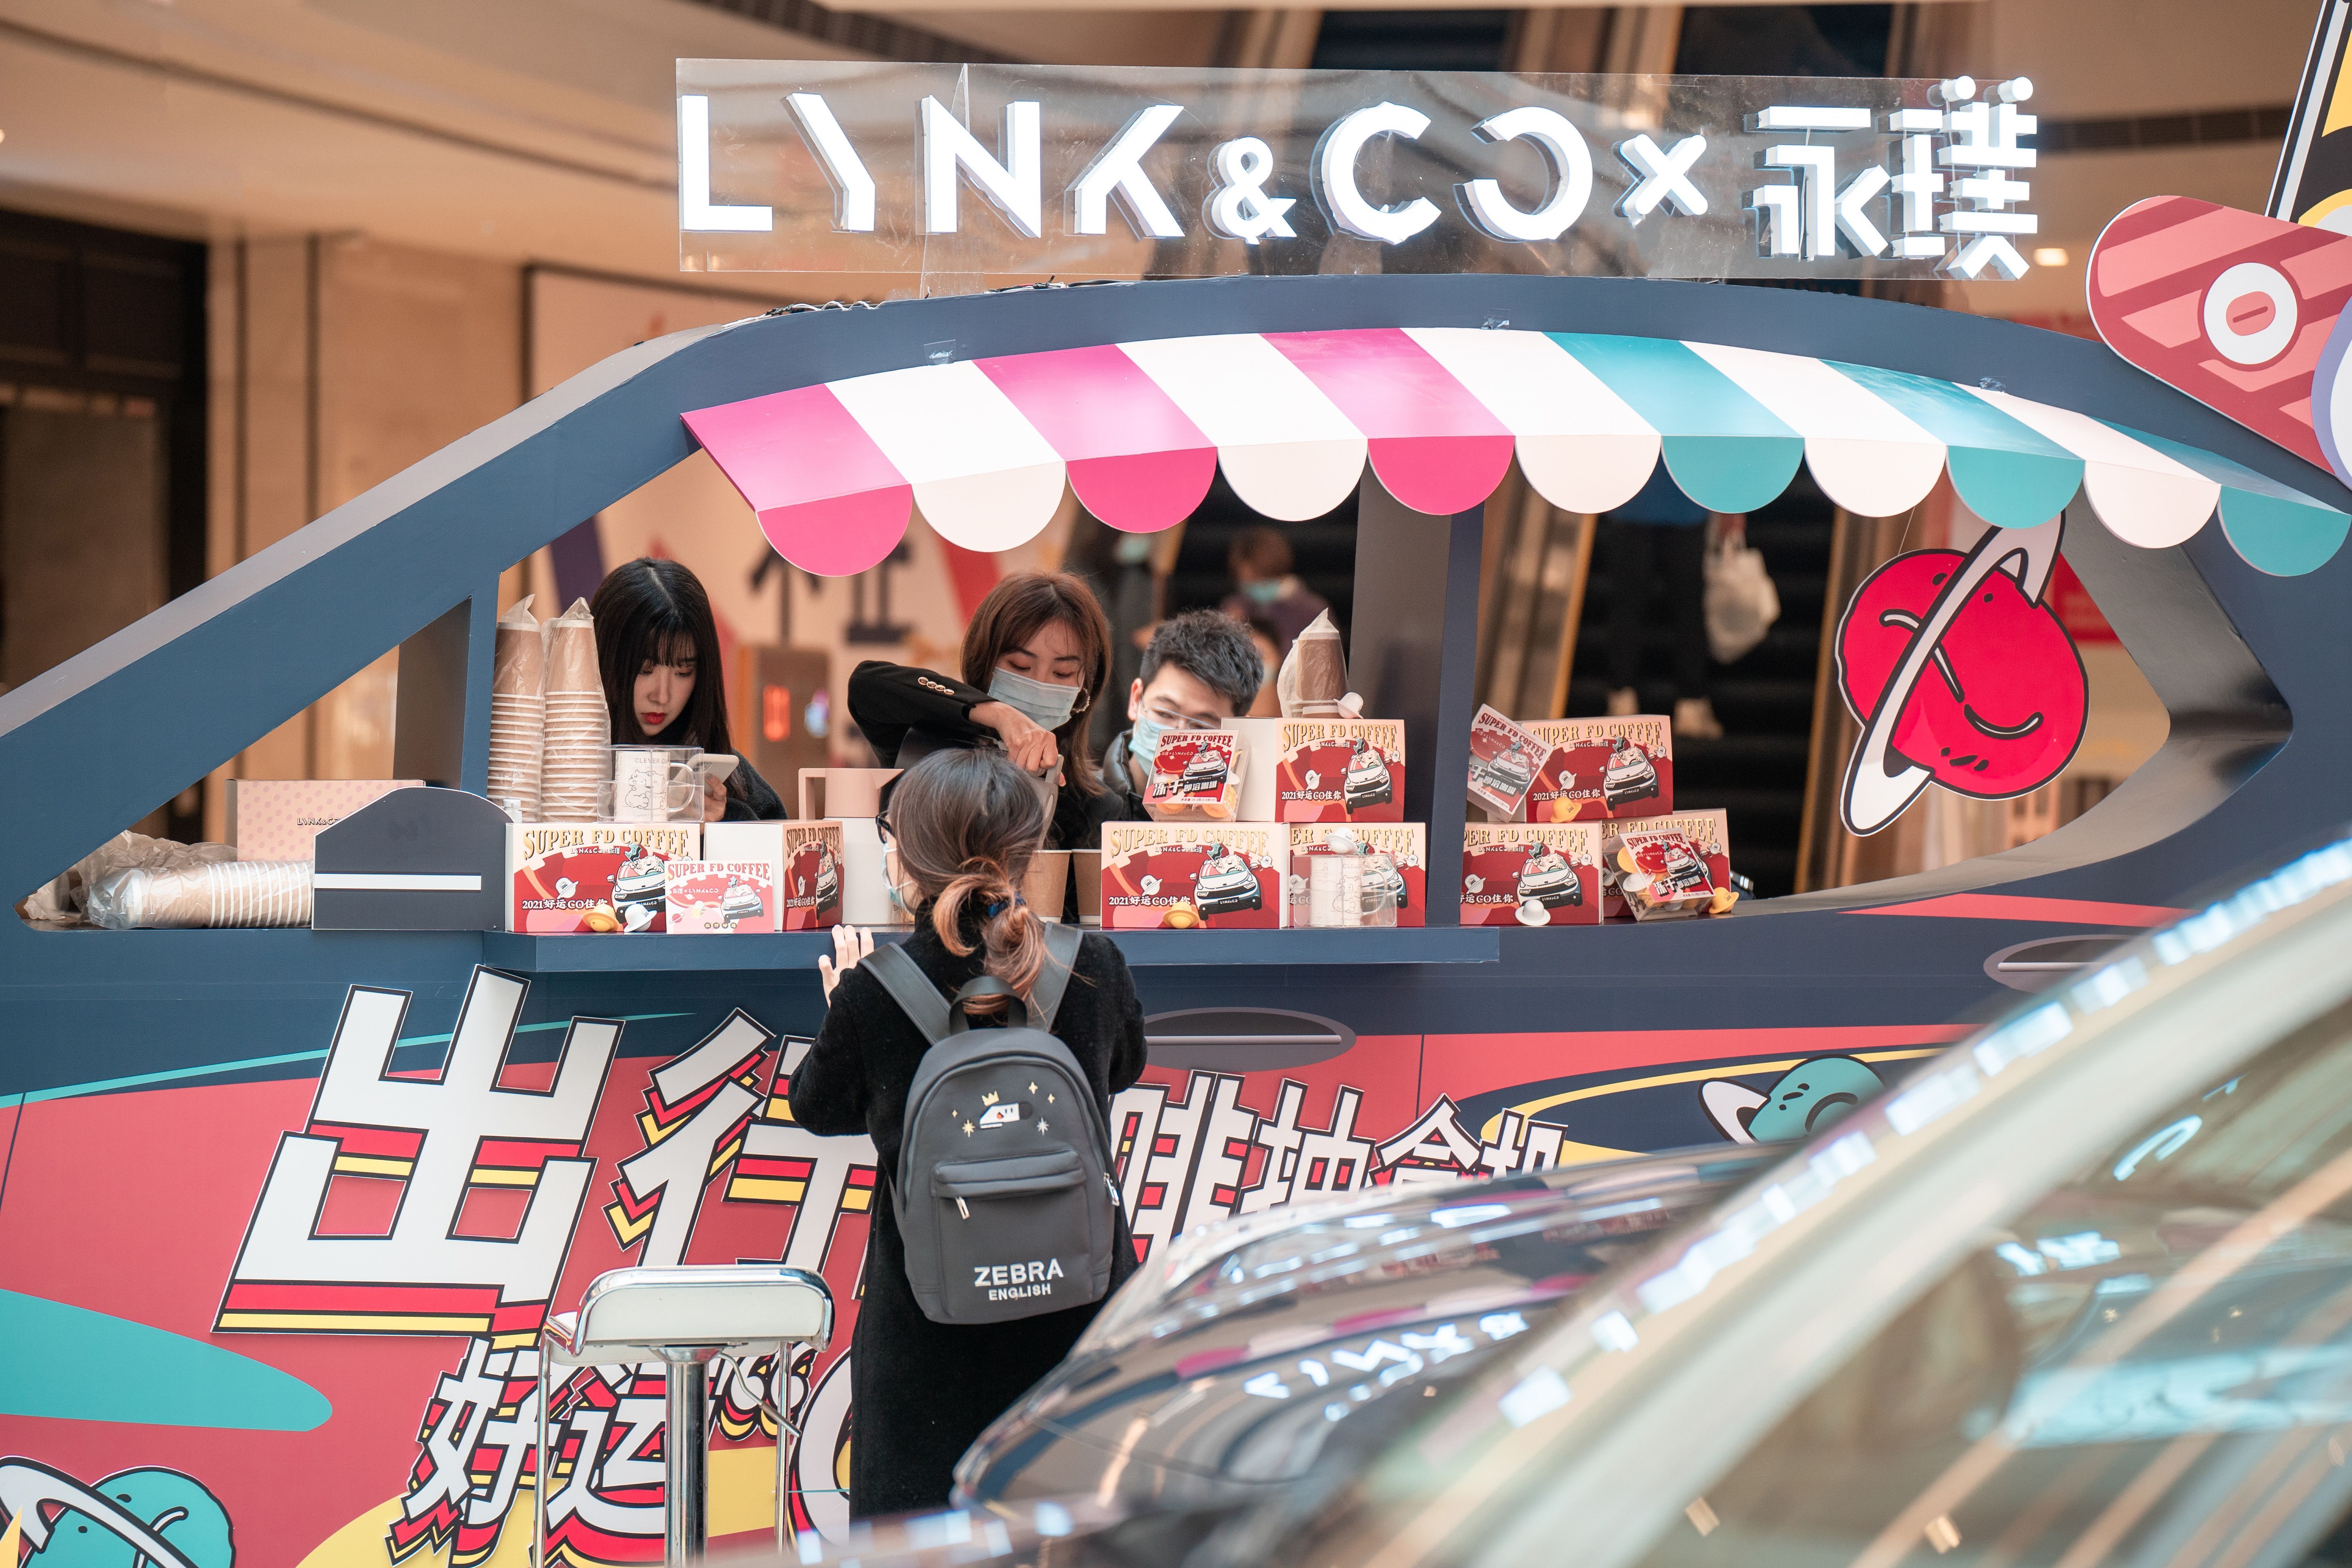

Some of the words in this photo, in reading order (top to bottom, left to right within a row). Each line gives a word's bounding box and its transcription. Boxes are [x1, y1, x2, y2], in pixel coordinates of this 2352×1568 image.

[1161, 735, 1188, 747] SUPER
[1203, 735, 1233, 747] COFFEE
[1283, 723, 1324, 753] SUPER
[1329, 724, 1346, 738] FD
[1349, 724, 1397, 752] COFFEE
[1478, 713, 1507, 731] SUPER
[1507, 728, 1518, 737] FD
[1519, 735, 1546, 761] COFFEE
[1585, 724, 1603, 738] FD
[1607, 722, 1662, 747] COFFEE
[523, 829, 584, 860] SUPER
[592, 829, 615, 844] FD
[620, 829, 689, 857] COFFEE
[786, 828, 806, 859] SUPER
[808, 828, 816, 842] FD
[818, 826, 840, 853] COFFEE
[1111, 828, 1168, 858] SUPER
[1176, 828, 1198, 843] FD
[1203, 828, 1269, 857] COFFEE
[1497, 829, 1519, 842] FD
[1524, 828, 1588, 854] COFFEE
[1627, 837, 1647, 849] SUPER
[1659, 833, 1686, 844] COFFEE
[668, 863, 704, 881] SUPER
[710, 863, 724, 872] FD
[727, 863, 770, 881] COFFEE
[974, 1258, 1063, 1287] ZEBRA
[989, 1283, 1051, 1301] ENGLISH
